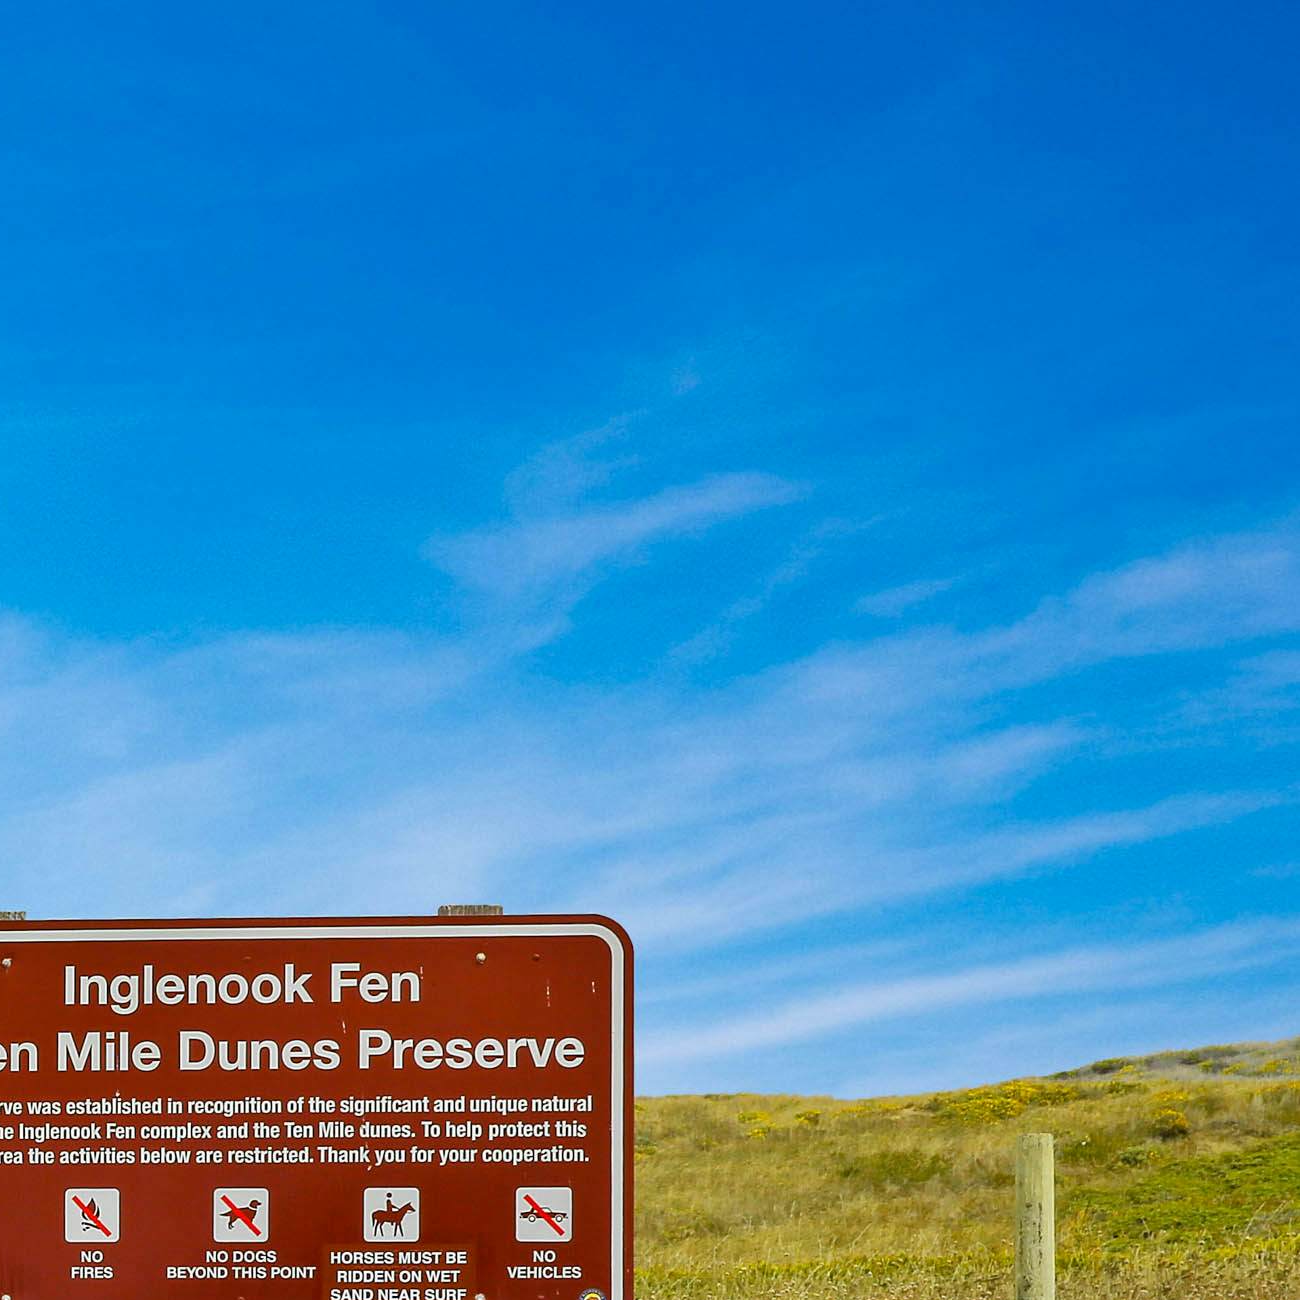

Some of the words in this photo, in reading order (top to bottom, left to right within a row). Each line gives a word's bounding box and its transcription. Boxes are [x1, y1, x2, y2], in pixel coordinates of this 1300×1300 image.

[64, 963, 314, 1015] Inglenook
[331, 962, 421, 1003] Fen
[57, 1031, 161, 1072] Mile
[179, 1030, 340, 1071] Dunes
[359, 1029, 585, 1070] Preserve
[26, 1101, 62, 1115] was
[65, 1097, 162, 1115] established
[167, 1097, 183, 1114] in
[187, 1096, 282, 1118] recognition
[286, 1096, 305, 1114] of
[307, 1096, 336, 1113] the
[339, 1095, 430, 1117] significant
[433, 1095, 466, 1113] and
[469, 1095, 528, 1116] unique
[531, 1095, 592, 1112] natural
[19, 1122, 102, 1143] Inglenook
[106, 1122, 136, 1140] Fen
[140, 1122, 212, 1143] complex
[216, 1122, 249, 1139] and
[252, 1122, 281, 1139] the
[283, 1121, 314, 1139] Ten
[318, 1121, 355, 1138] Mile
[359, 1121, 417, 1139] dunes.
[420, 1120, 441, 1138] To
[445, 1120, 483, 1141] help
[488, 1120, 551, 1141] protect
[554, 1120, 587, 1138] this
[27, 1147, 55, 1164] the
[59, 1147, 136, 1164] activities
[140, 1147, 192, 1164] below
[195, 1150, 223, 1164] are
[227, 1146, 314, 1164] restricted.
[316, 1146, 370, 1163] Thank
[374, 1149, 406, 1167] you
[409, 1145, 436, 1163] for
[438, 1149, 478, 1166] your
[481, 1145, 590, 1166] cooperation.
[80, 1250, 104, 1263] NO
[206, 1250, 229, 1263] NO
[232, 1250, 277, 1263] DOGS
[330, 1251, 395, 1265] HORSES
[398, 1251, 442, 1265] MUST
[445, 1251, 467, 1264] BE
[533, 1250, 556, 1263] NO
[71, 1266, 114, 1279] FIRES
[166, 1266, 228, 1279] BEYOND
[231, 1266, 267, 1279] THIS
[270, 1266, 317, 1279] POINT
[337, 1270, 395, 1283] RIDDEN
[398, 1270, 422, 1283] ON
[425, 1270, 461, 1283] WET
[506, 1266, 582, 1279] VEHICLES
